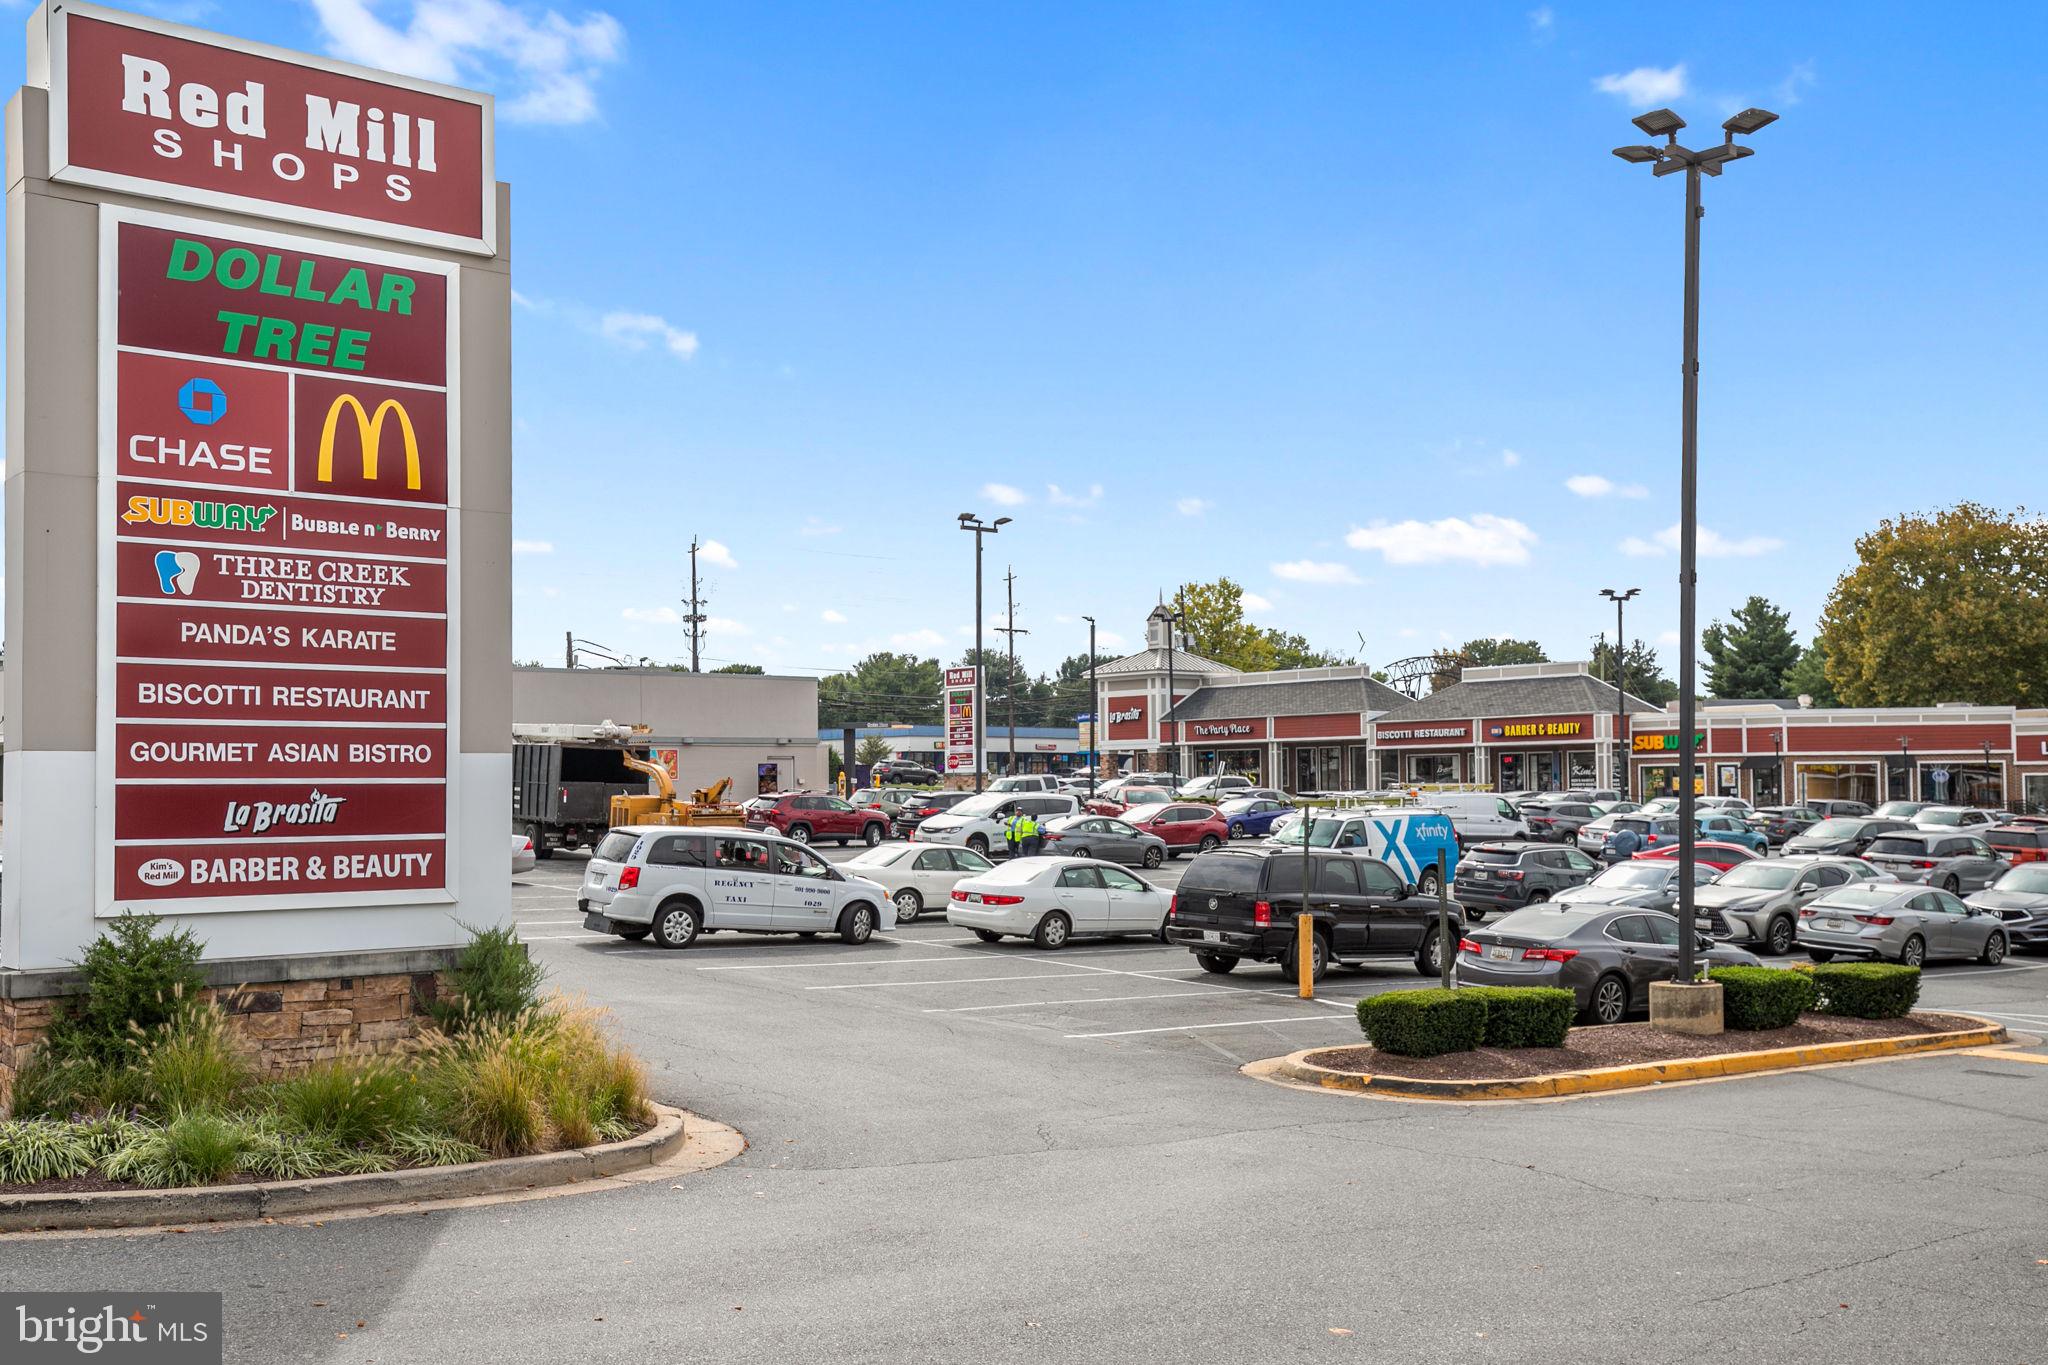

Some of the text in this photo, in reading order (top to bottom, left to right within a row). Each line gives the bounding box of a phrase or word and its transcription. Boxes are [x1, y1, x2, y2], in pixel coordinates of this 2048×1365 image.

[122, 53, 437, 173] Red Mill
[153, 129, 412, 202] SHOPS
[166, 239, 416, 315] DOLLAR
[217, 310, 372, 371] TREE
[129, 434, 272, 475] CHASE
[121, 496, 277, 532] SUBWAY
[214, 554, 410, 587] THREE CREEK
[241, 580, 385, 605] DENTISTRY
[181, 622, 396, 651] PANDA'S KARATE
[138, 682, 430, 710] BISCOTTI RESTAURANT
[1194, 723, 1250, 736] The Party Place
[1377, 728, 1466, 739] BISCOTTI RESTAURANT
[1504, 724, 1537, 736] BARBER
[1539, 724, 1545, 735] &
[1547, 722, 1581, 735] BEAUTY
[130, 741, 432, 763] GOURMET ASIAN BISTRO
[223, 790, 346, 833] La Brasita
[1415, 822, 1448, 841] xfinity
[144, 871, 179, 880] Red Mill
[150, 861, 173, 870] Kim's
[190, 853, 432, 884] BARBER & BEAUTY
[714, 880, 755, 888] REGENCY
